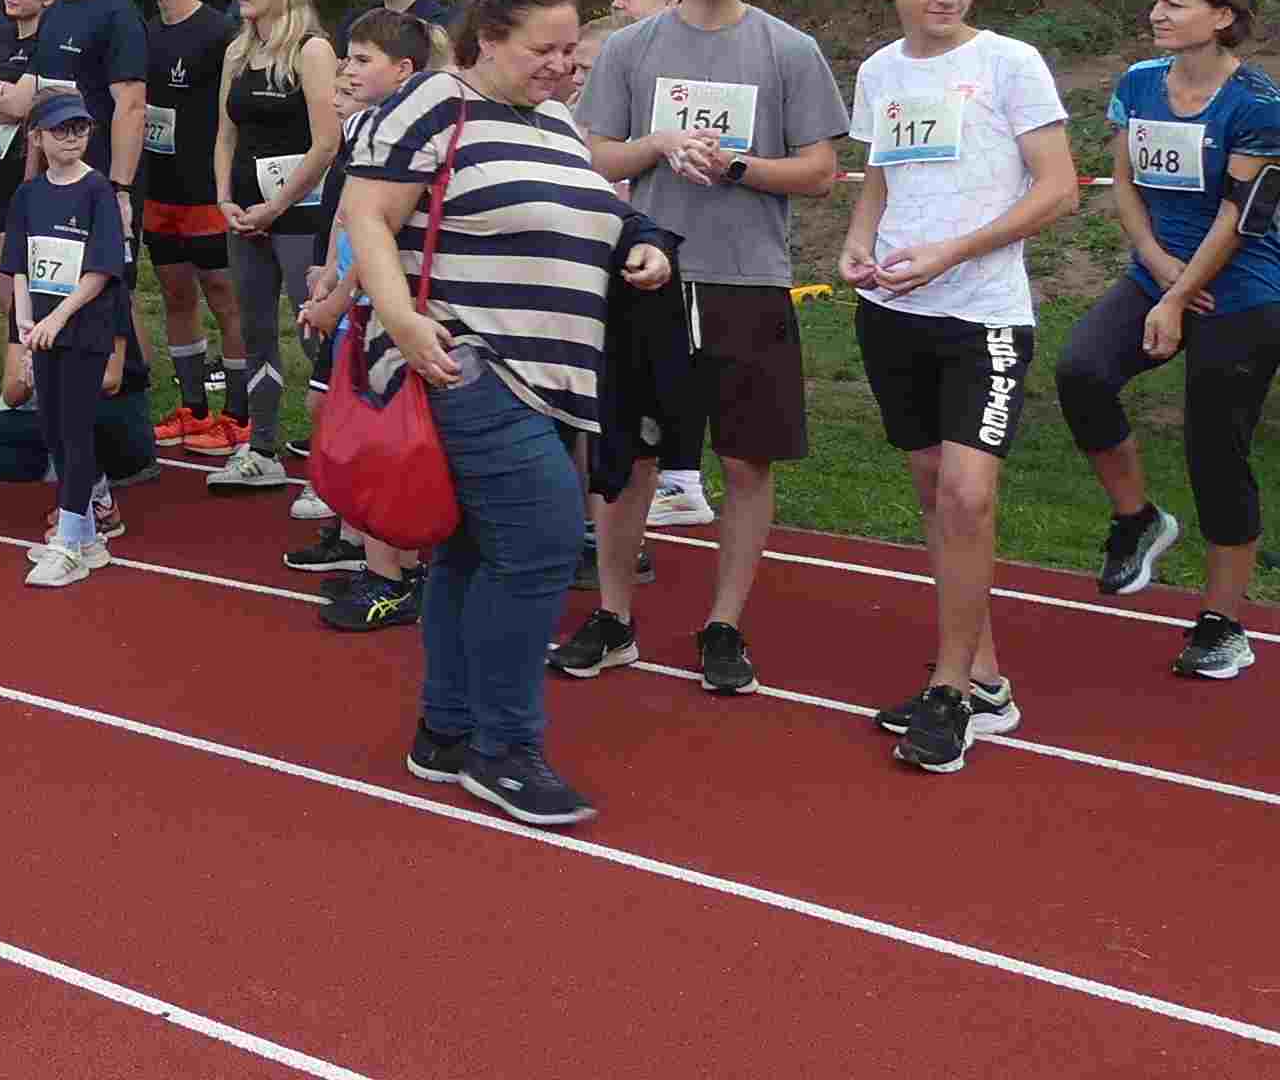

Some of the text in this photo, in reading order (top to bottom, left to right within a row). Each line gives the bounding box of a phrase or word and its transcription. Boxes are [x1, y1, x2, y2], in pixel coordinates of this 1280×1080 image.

[676, 107, 730, 134] 154
[892, 120, 936, 147] 117
[1138, 148, 1179, 173] 048
